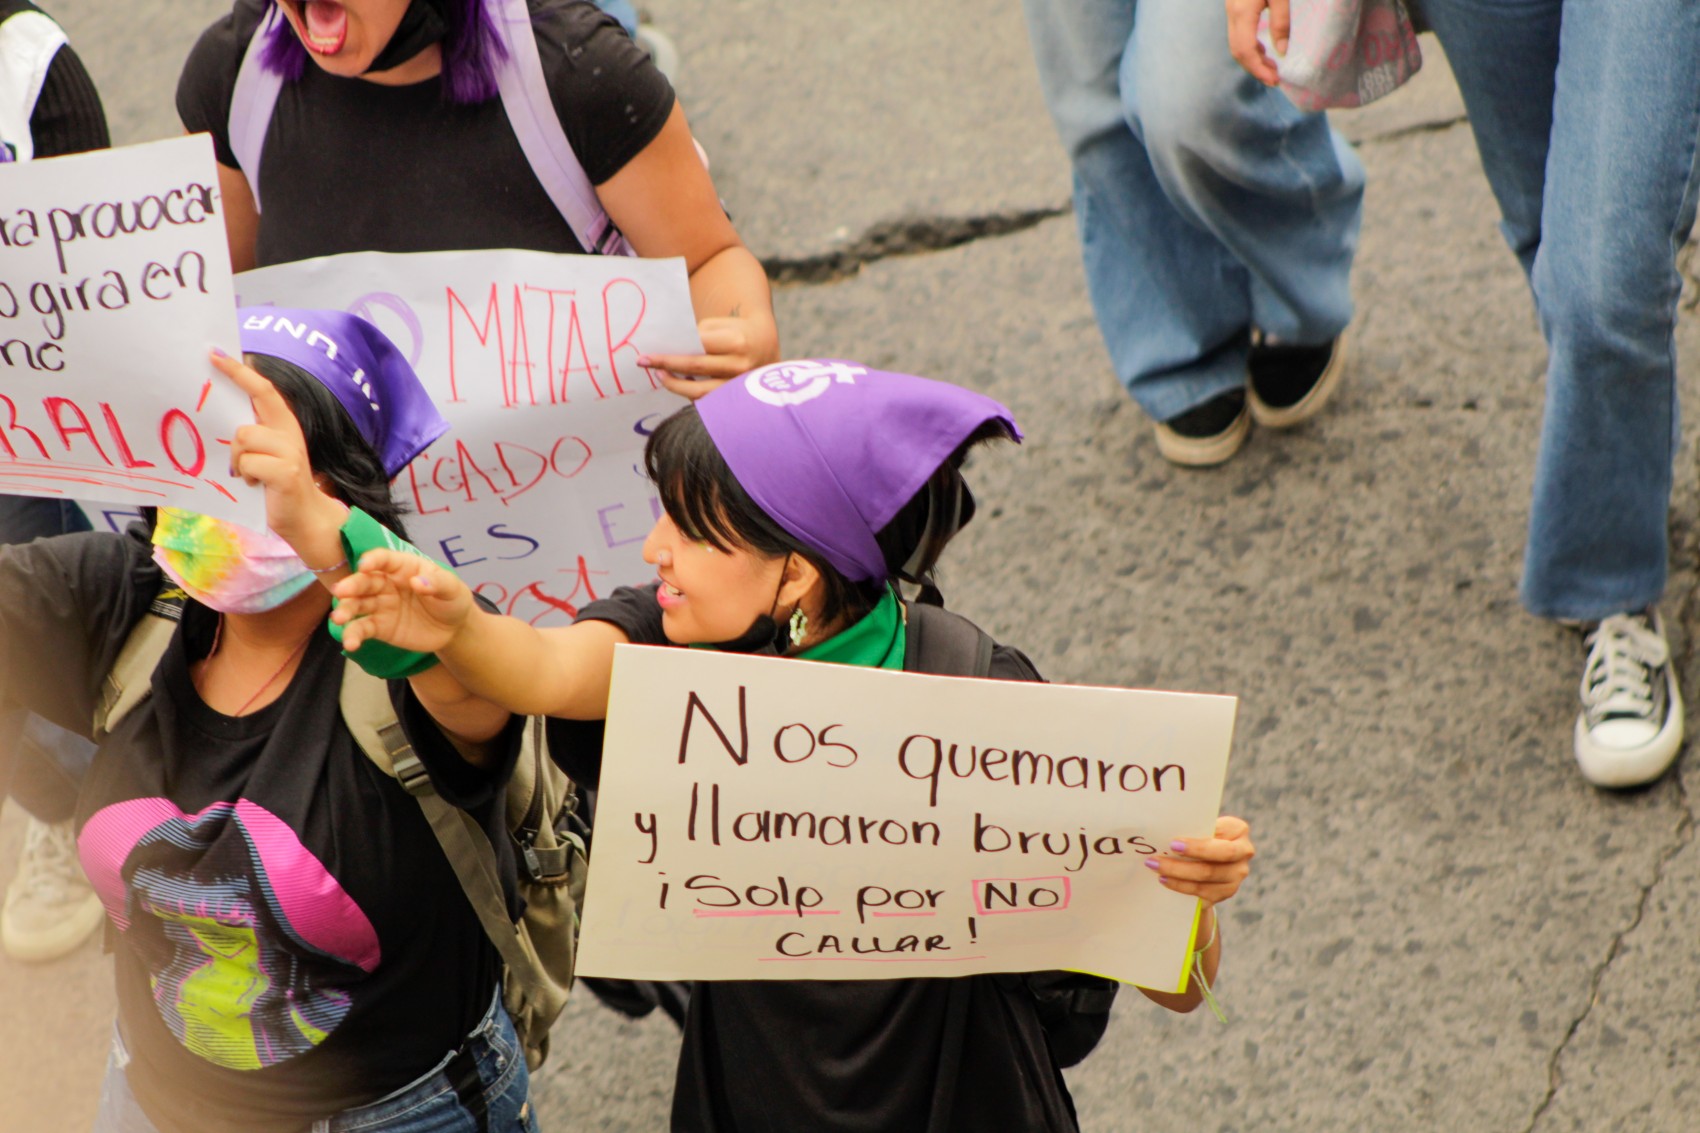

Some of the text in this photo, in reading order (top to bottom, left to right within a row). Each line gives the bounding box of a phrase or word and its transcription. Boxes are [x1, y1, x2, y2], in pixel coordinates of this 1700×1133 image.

[29, 280, 130, 341] gira
[140, 250, 209, 301] en
[243, 314, 338, 361] UNA
[446, 277, 662, 410] MATAR
[438, 523, 540, 568] ES
[678, 685, 1186, 808] Nos quemaron
[634, 811, 658, 864] y
[688, 781, 941, 847] llamaron
[856, 885, 946, 924] por
